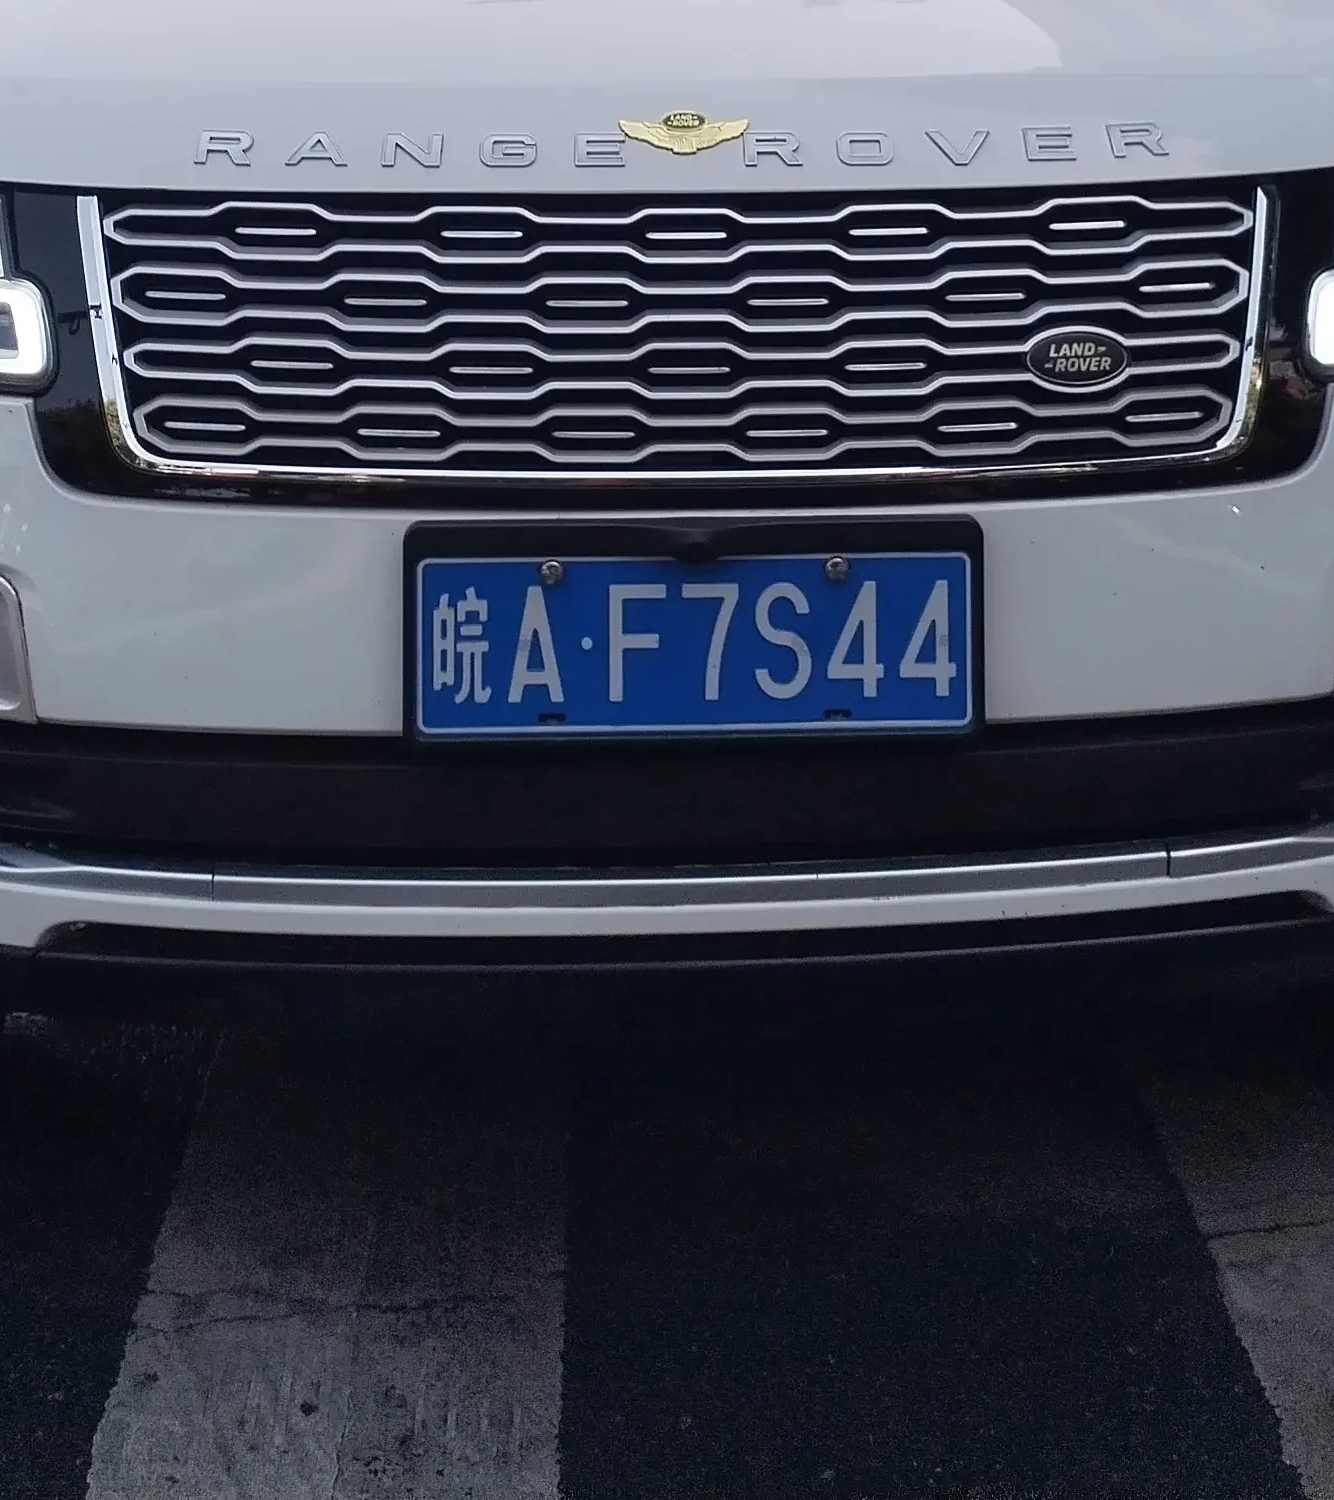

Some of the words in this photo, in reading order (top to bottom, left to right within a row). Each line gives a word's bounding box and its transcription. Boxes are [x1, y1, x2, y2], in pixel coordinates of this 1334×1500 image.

[193, 129, 626, 167] RANGE
[743, 121, 1170, 167] ROVER
[1049, 342, 1096, 357] LAND
[1054, 356, 1111, 373] ROVER
[433, 579, 958, 704] 皖A·F7S44
